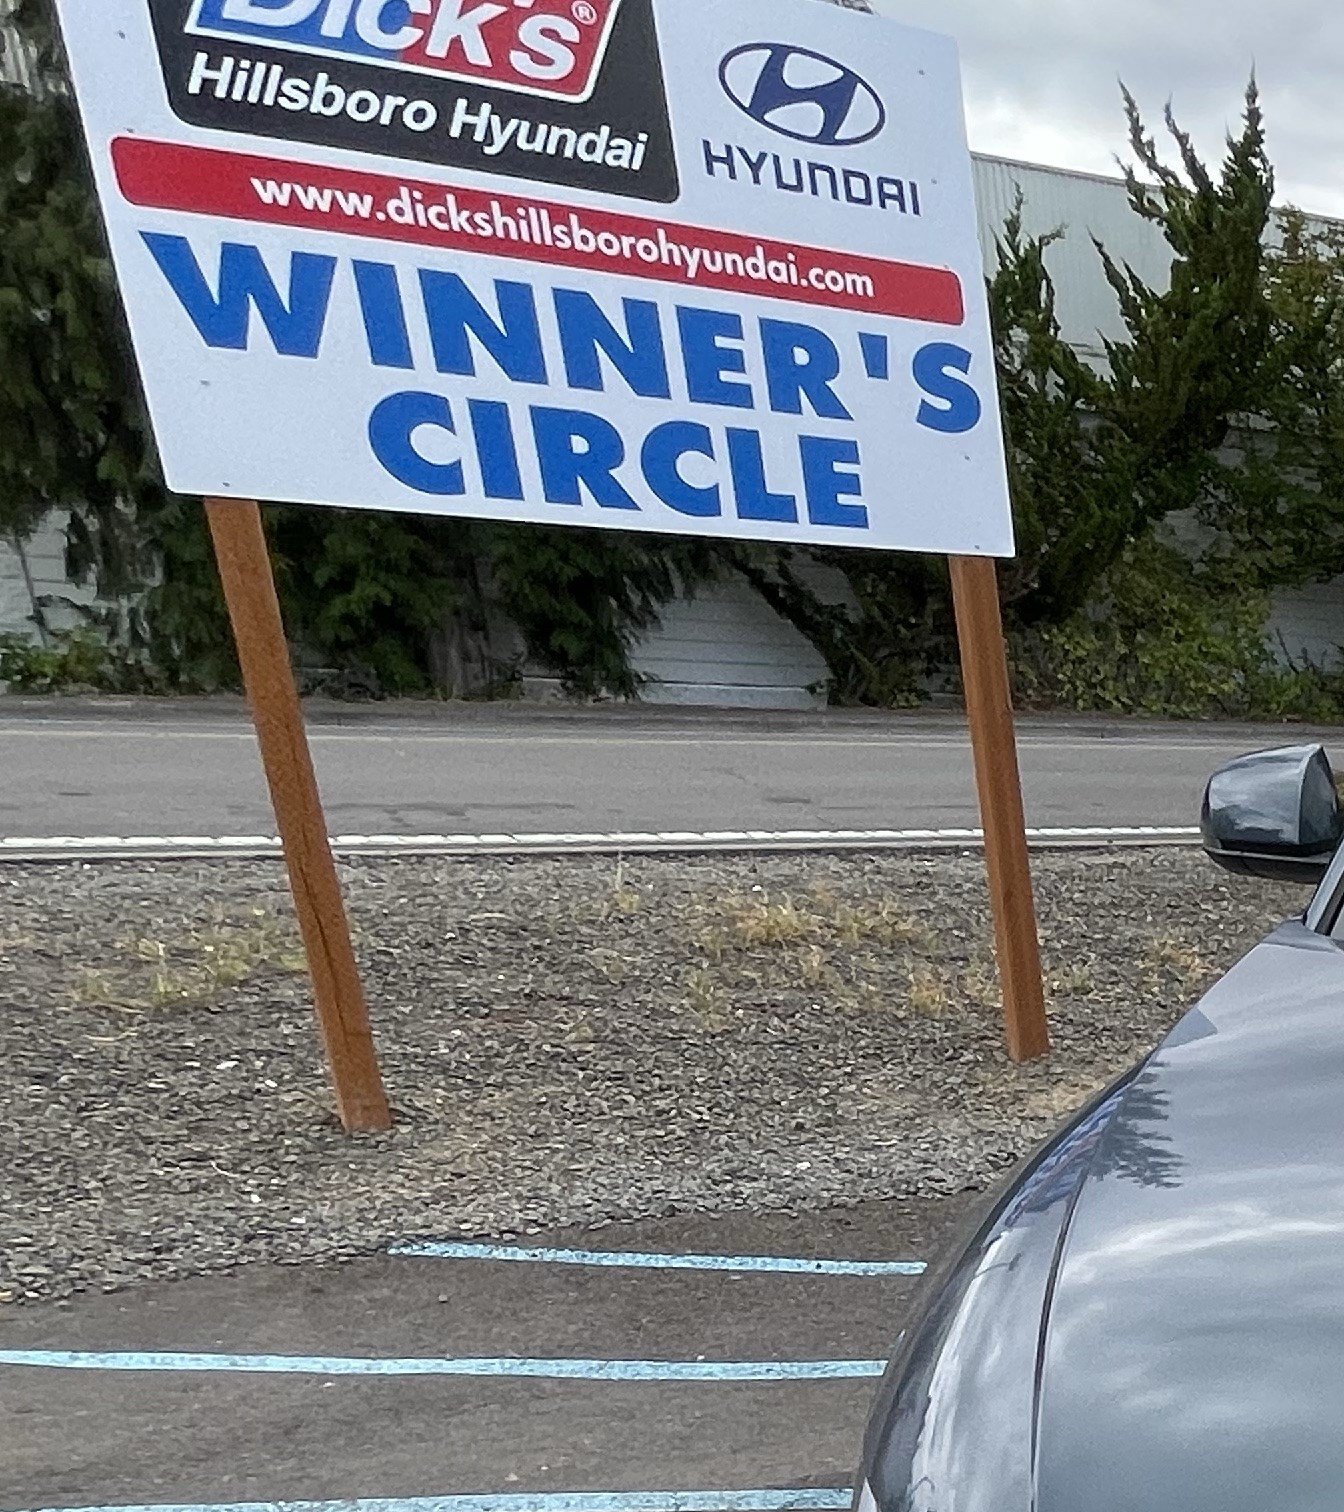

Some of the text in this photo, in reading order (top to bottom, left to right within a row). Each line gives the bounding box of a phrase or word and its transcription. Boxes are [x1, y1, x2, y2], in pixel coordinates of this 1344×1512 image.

[187, 52, 649, 172] Hillsboro Hyundai
[250, 173, 875, 299] www.dickshillsborohyundai.com
[703, 139, 922, 216] HYUNDAI
[140, 231, 982, 433] WINNER'S
[367, 390, 870, 529] CIRCLE
